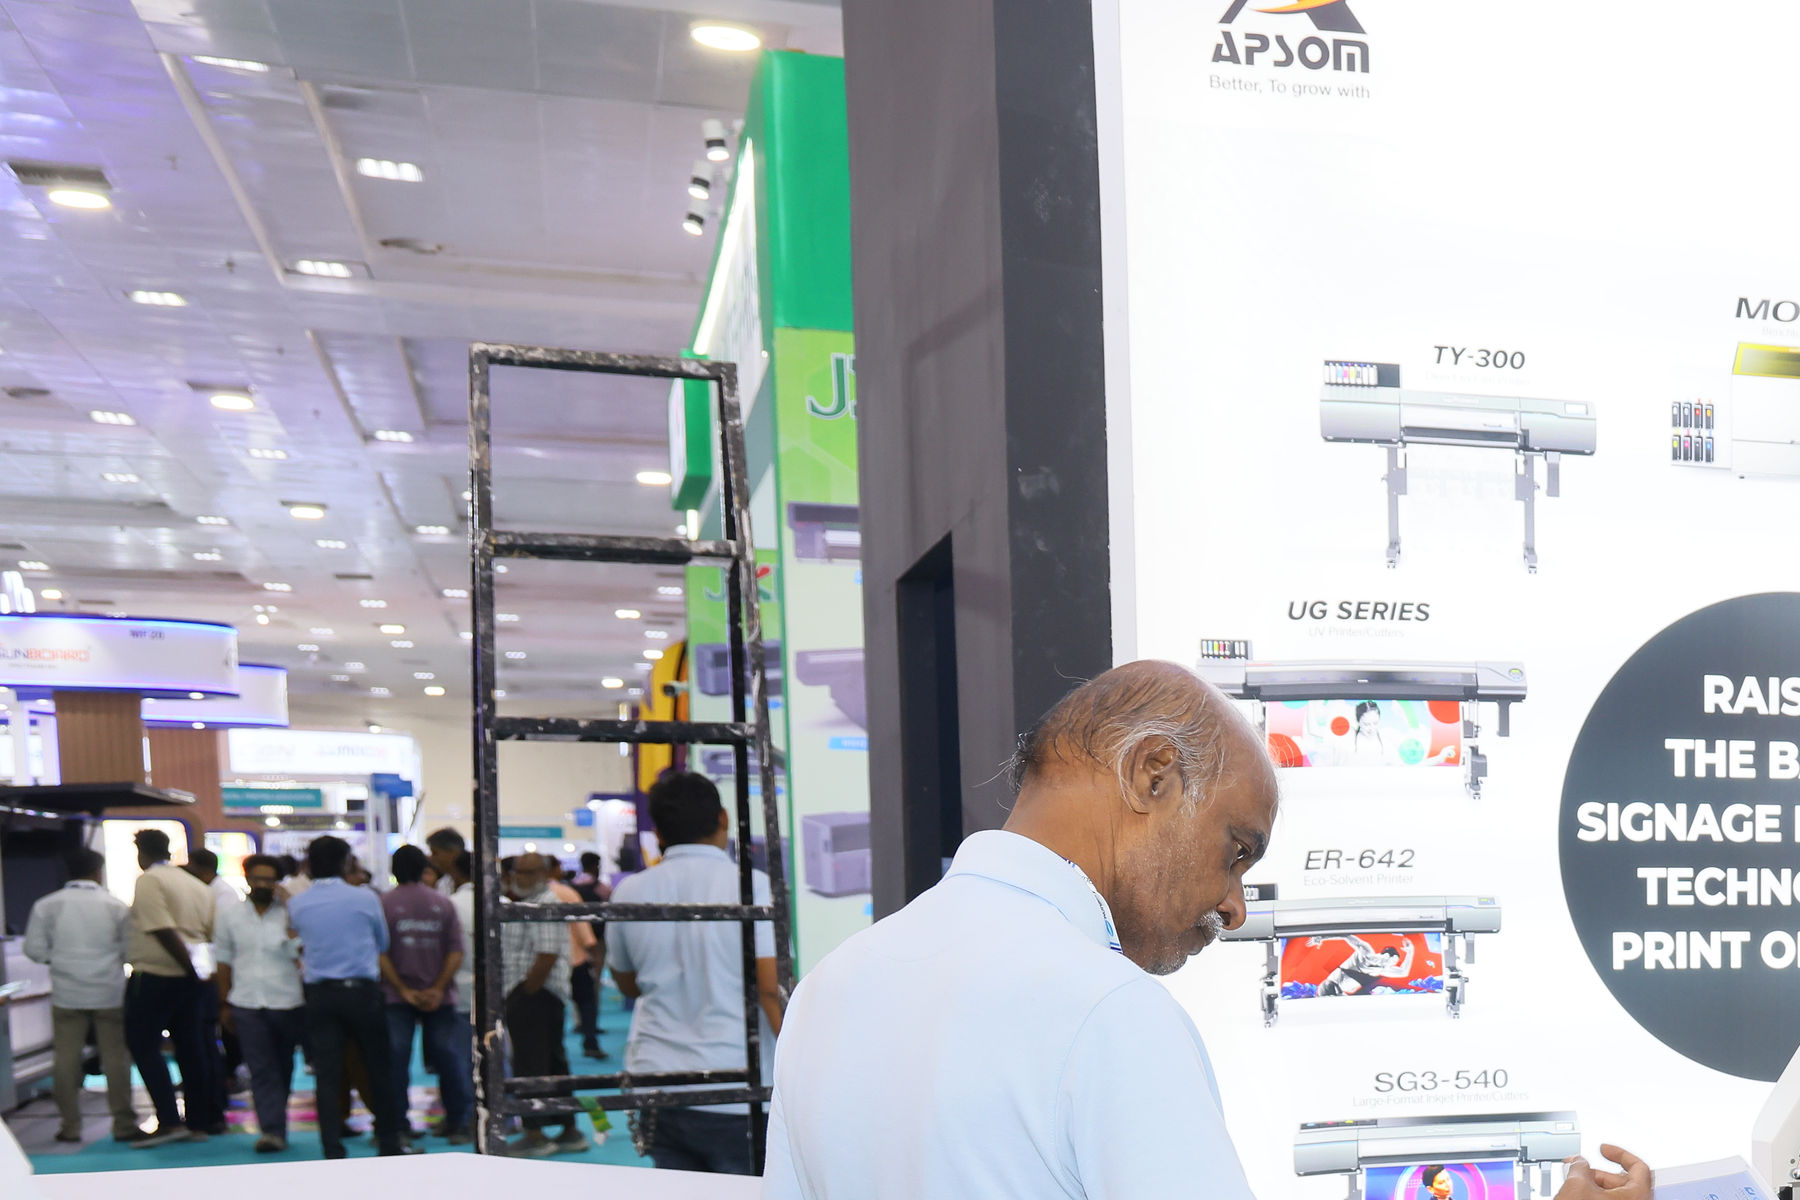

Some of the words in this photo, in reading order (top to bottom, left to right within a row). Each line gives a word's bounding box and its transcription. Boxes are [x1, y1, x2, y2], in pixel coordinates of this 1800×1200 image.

[1209, 74, 1263, 94] Better,
[1269, 78, 1287, 93] To
[1292, 83, 1331, 97] grow
[1337, 85, 1371, 99] with
[1433, 345, 1526, 370] TY-300
[1286, 600, 1328, 621] UG
[1336, 600, 1431, 622] SERIES
[1664, 738, 1757, 779] THE
[1576, 801, 1782, 842] SIGNAGE
[1303, 848, 1415, 871] ER-642
[1612, 930, 1751, 970] PRINT
[1373, 1068, 1509, 1093] SG3-540
